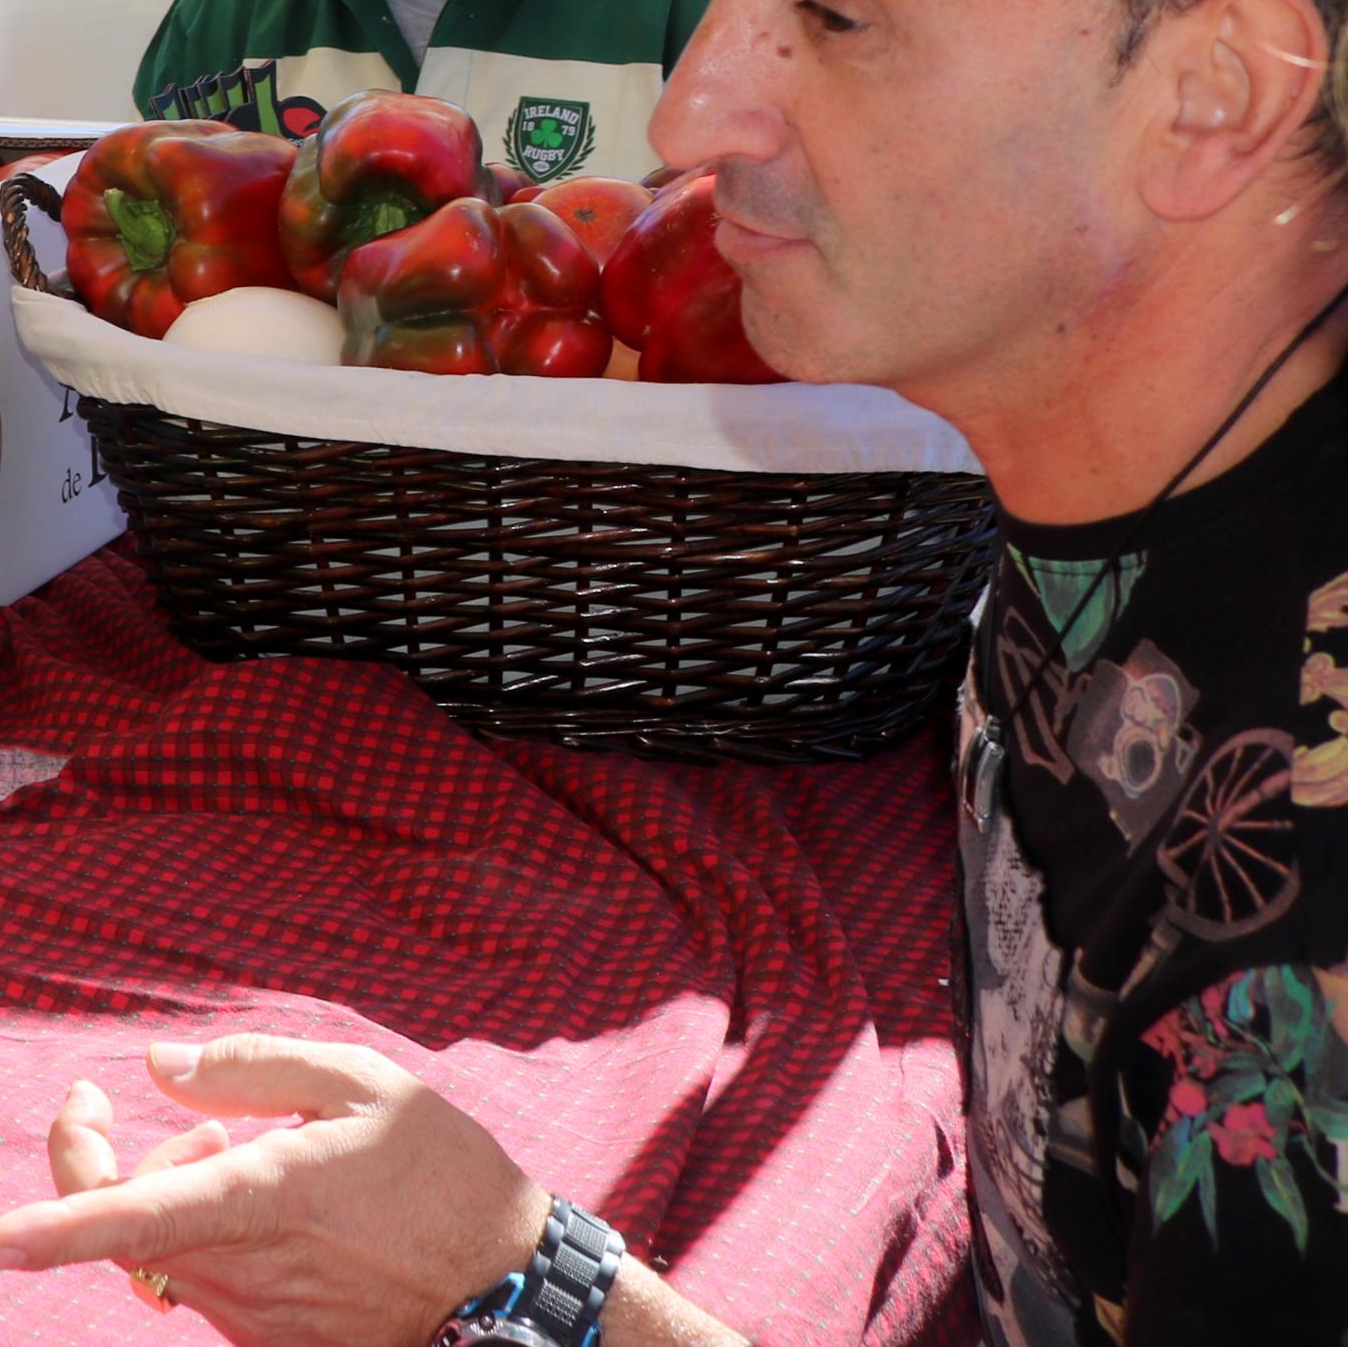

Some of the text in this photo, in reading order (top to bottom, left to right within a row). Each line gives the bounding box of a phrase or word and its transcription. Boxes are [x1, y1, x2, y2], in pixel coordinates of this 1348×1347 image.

[523, 105, 579, 125] IRELAND
[522, 121, 576, 137] 18 79
[524, 145, 565, 161] RUGBY
[61, 467, 82, 503] de
